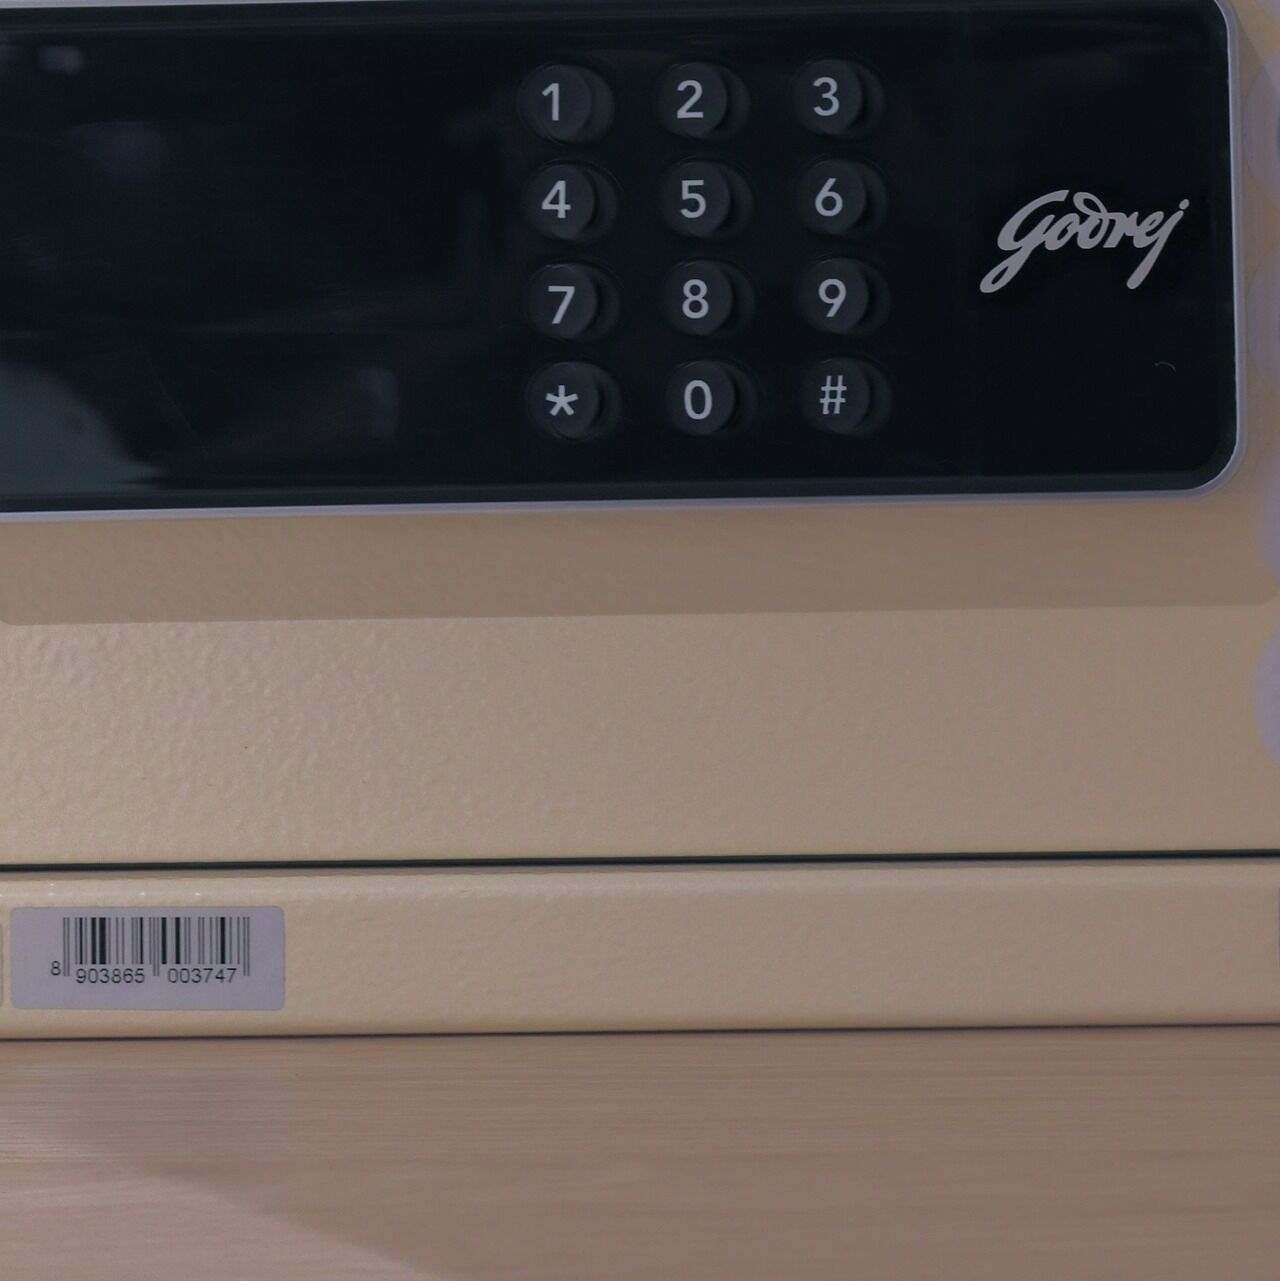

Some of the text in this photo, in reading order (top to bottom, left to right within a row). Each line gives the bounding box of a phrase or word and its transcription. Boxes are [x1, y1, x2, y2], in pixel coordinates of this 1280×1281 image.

[541, 77, 840, 120] 1 2 3
[541, 178, 843, 219] 4 5 6
[980, 189, 1190, 293] Godrej
[548, 278, 847, 324] 7 8 9
[683, 380, 712, 419] 0
[50, 961, 237, 985] 8 903865 003747
